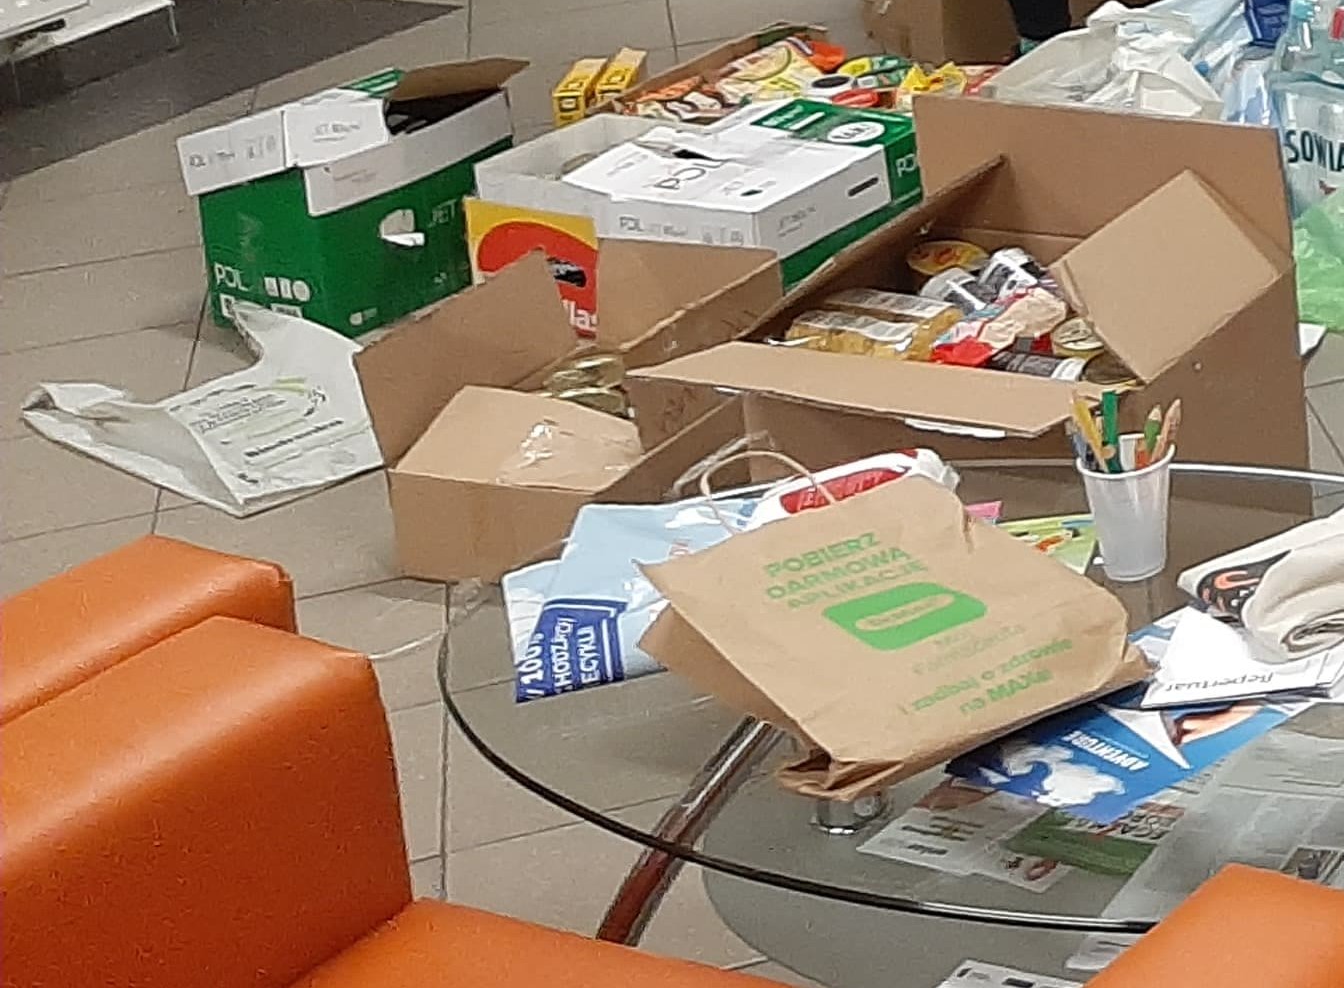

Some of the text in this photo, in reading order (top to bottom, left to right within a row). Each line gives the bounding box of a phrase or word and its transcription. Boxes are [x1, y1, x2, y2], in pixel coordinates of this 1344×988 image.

[213, 262, 250, 293] POL
[763, 531, 881, 578] POBIERZ
[1164, 671, 1274, 693] Repertuar
[1060, 730, 1150, 771] ADVENTURE
